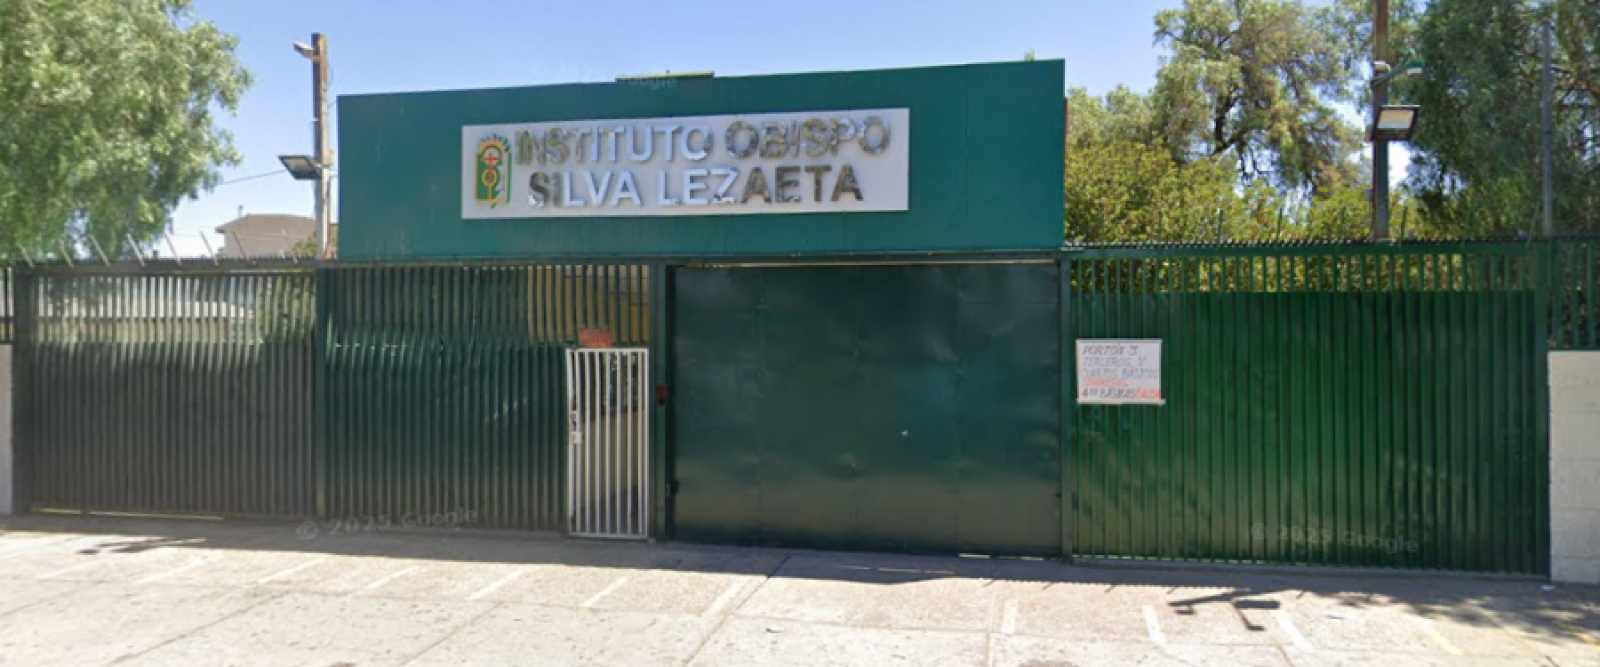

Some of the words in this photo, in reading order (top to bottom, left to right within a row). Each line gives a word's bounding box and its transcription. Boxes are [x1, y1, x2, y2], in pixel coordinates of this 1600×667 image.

[515, 124, 714, 166] INSTITUTO
[725, 116, 891, 159] OBISPO
[527, 170, 643, 208] SILVA
[658, 164, 865, 206] LEZAETA
